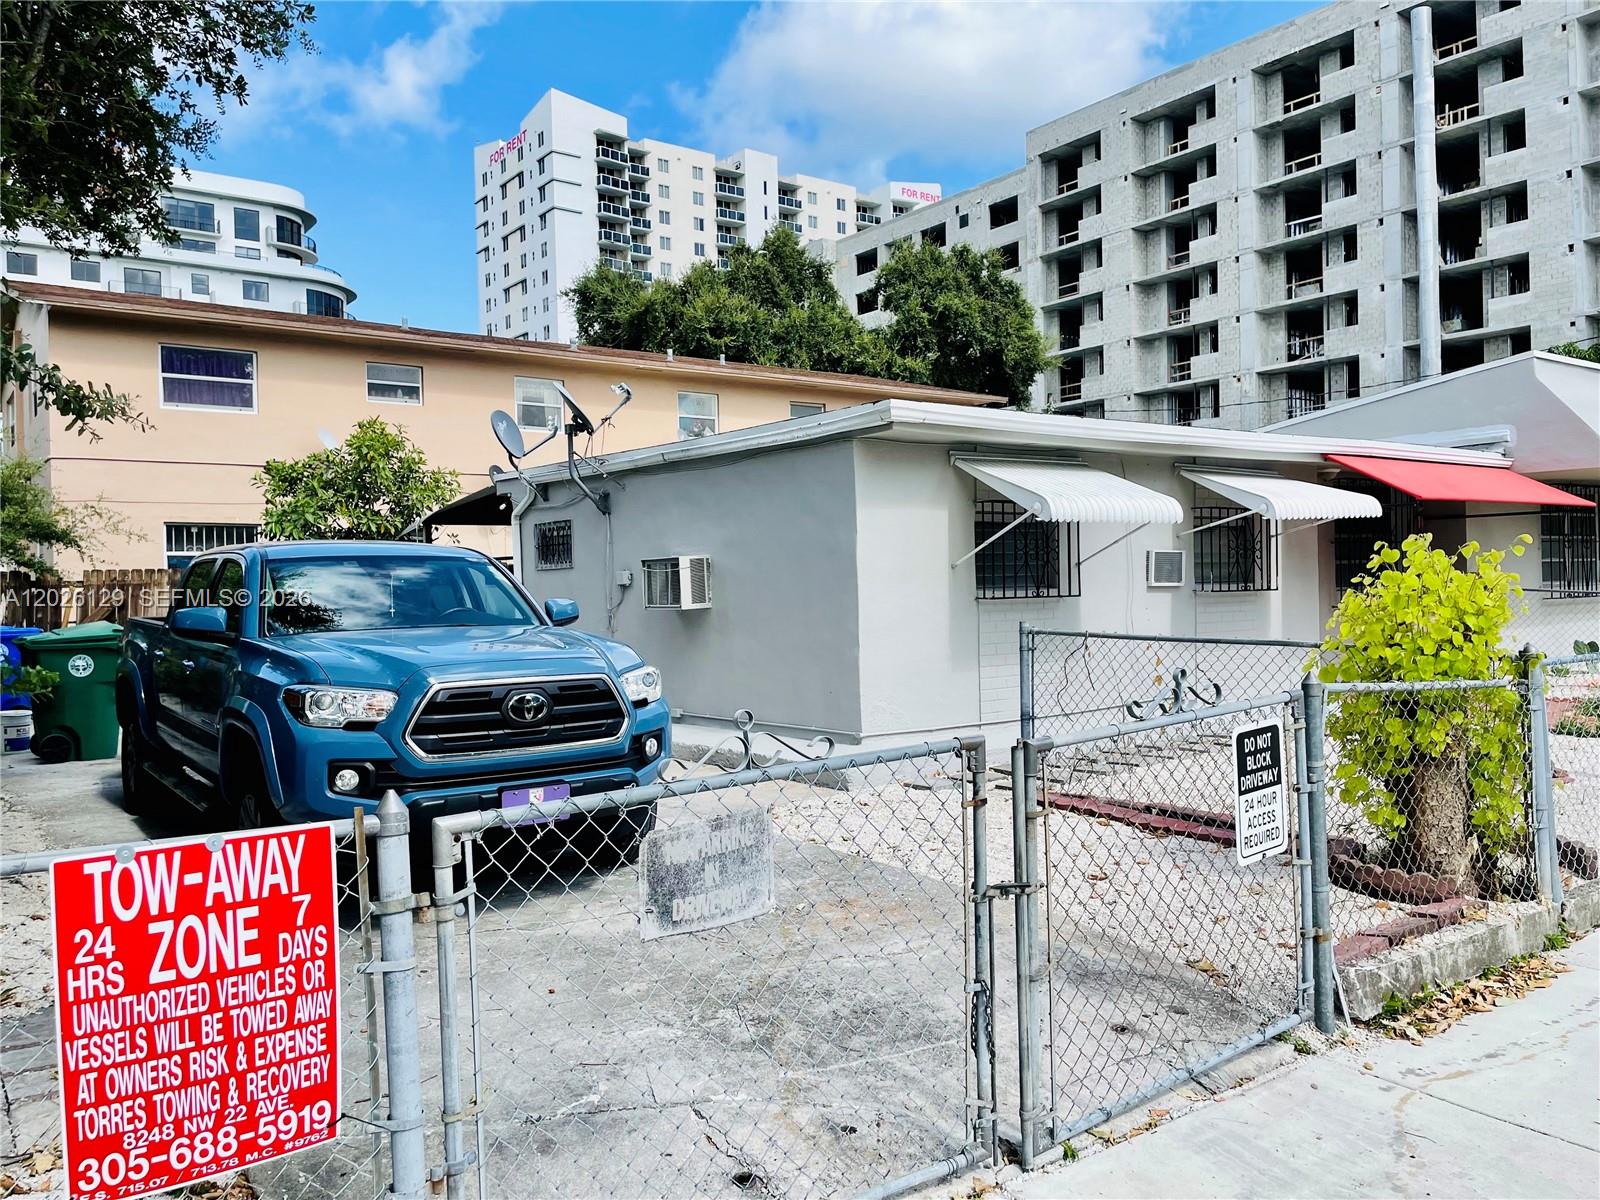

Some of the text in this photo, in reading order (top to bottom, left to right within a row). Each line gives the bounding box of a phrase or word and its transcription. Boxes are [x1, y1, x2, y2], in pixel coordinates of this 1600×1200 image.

[489, 129, 527, 167] FOR RENT
[901, 187, 940, 203] FOR RENT
[1244, 733, 1272, 753] DO NOT
[1246, 751, 1272, 771] BLOCK
[1240, 767, 1279, 792] DRIVEWAY
[1244, 791, 1277, 814] 24 HOUR
[1244, 826, 1280, 850] REQUIRED
[1247, 809, 1276, 830] ACCESS
[84, 833, 306, 925] TOW-AWAY
[67, 925, 328, 1001] HRS DAYS
[73, 894, 312, 985] 24 ZONE 7
[72, 959, 326, 1037] UNAUTHORIZED VEHICLES OR
[65, 988, 333, 1072] VESSELS WILL BE TOWED AWAY
[77, 1023, 327, 1106] AT OWNERS RISK & EXPENSE
[74, 1054, 331, 1142] TORRES TOWING & RECOVERY
[122, 1093, 294, 1151] 8248 NW 22 AVE.
[77, 1100, 332, 1193] 305-688-5919
[117, 1176, 169, 1197] 715.07
[176, 1170, 184, 1183] /
[190, 1157, 240, 1177] 713.78
[245, 1146, 278, 1161] M.C.
[284, 1130, 329, 1150] #9762
